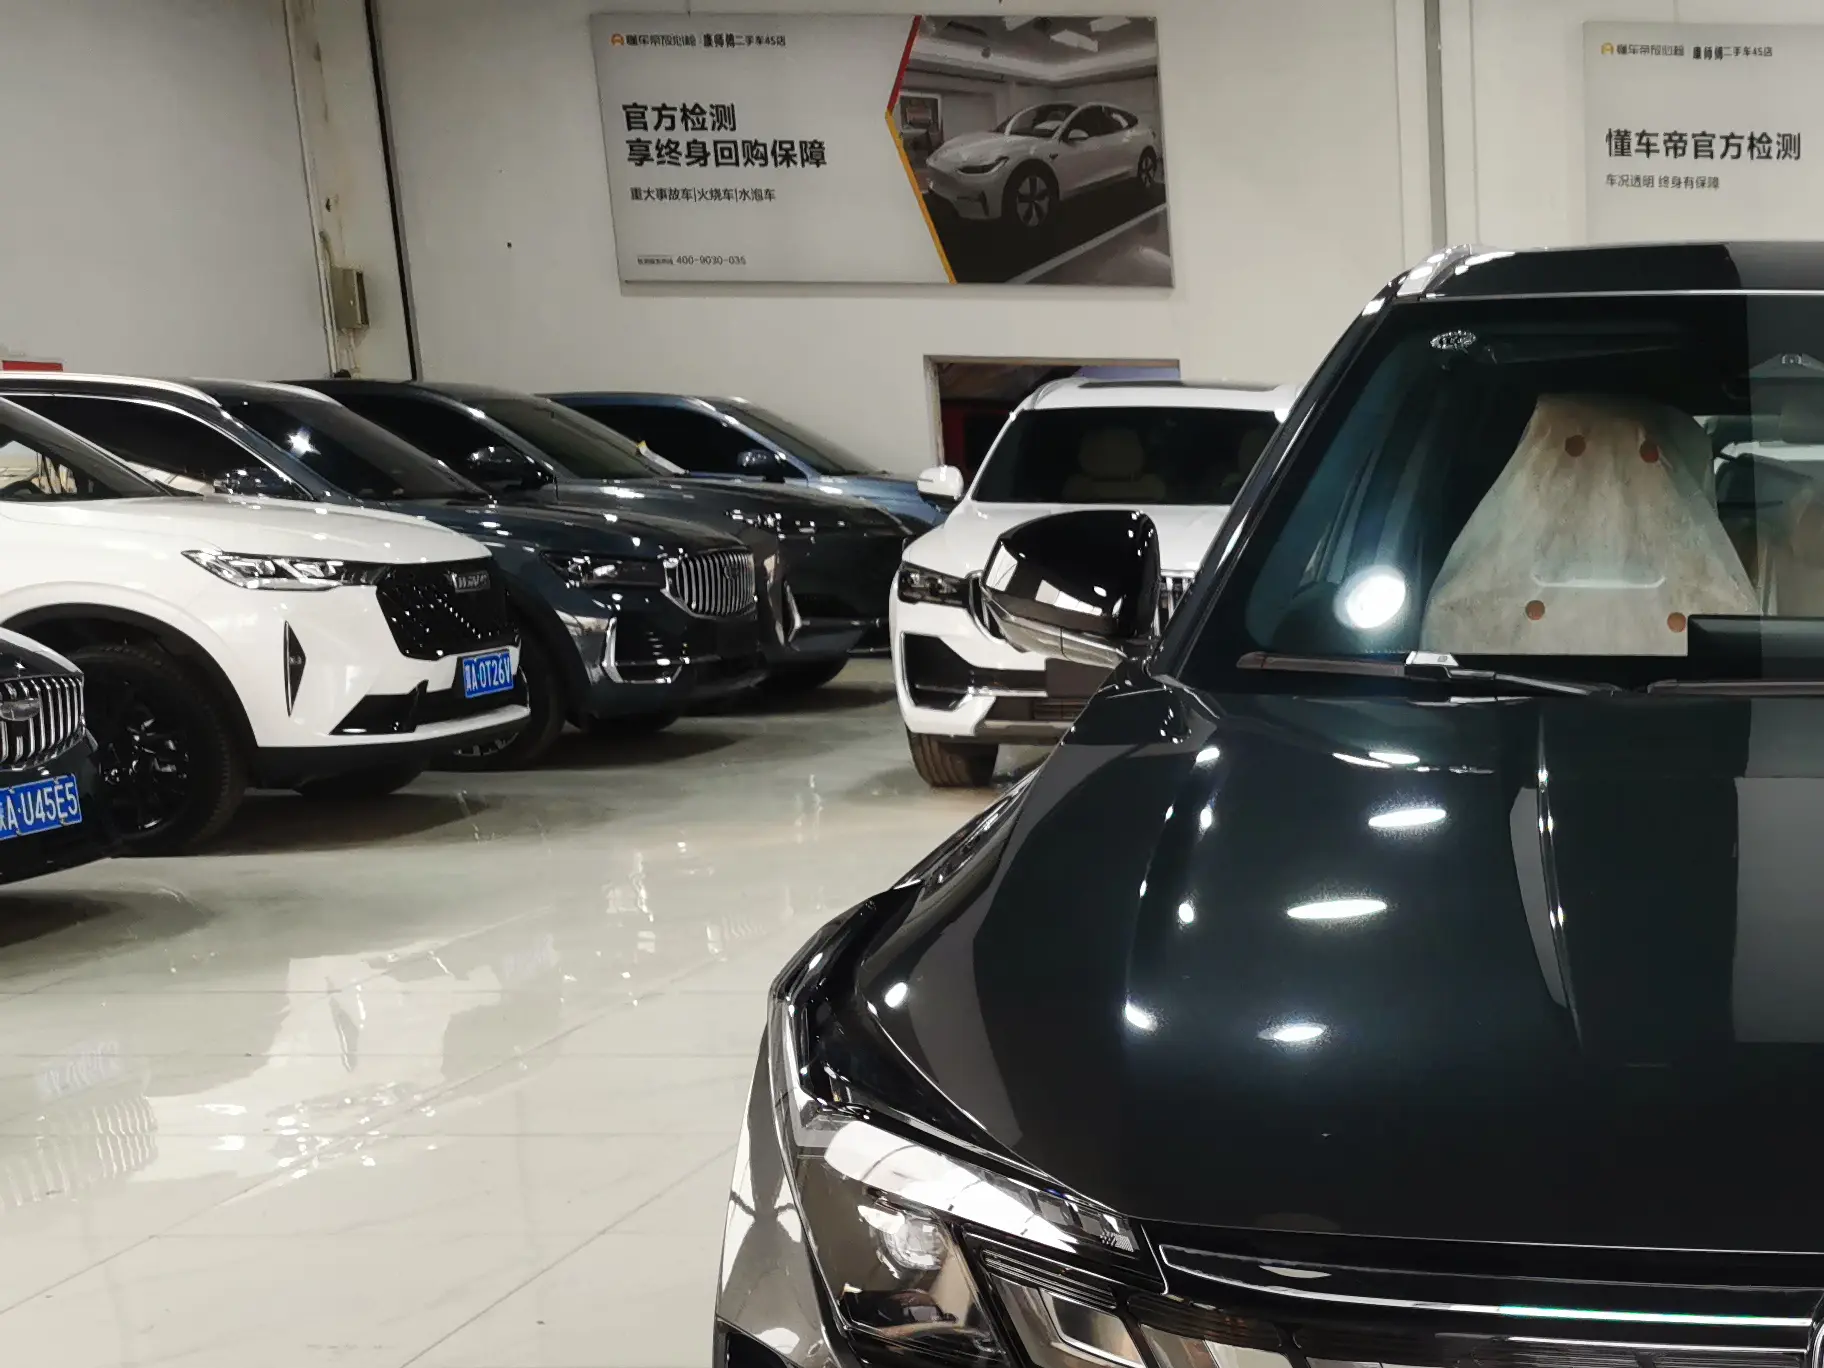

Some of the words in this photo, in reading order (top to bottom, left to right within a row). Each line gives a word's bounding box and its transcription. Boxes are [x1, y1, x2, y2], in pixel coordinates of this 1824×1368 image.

[622, 103, 736, 132] 官方检测
[626, 138, 827, 168] 享终身回购保障
[1606, 128, 1801, 160] 懂车帝官方检测
